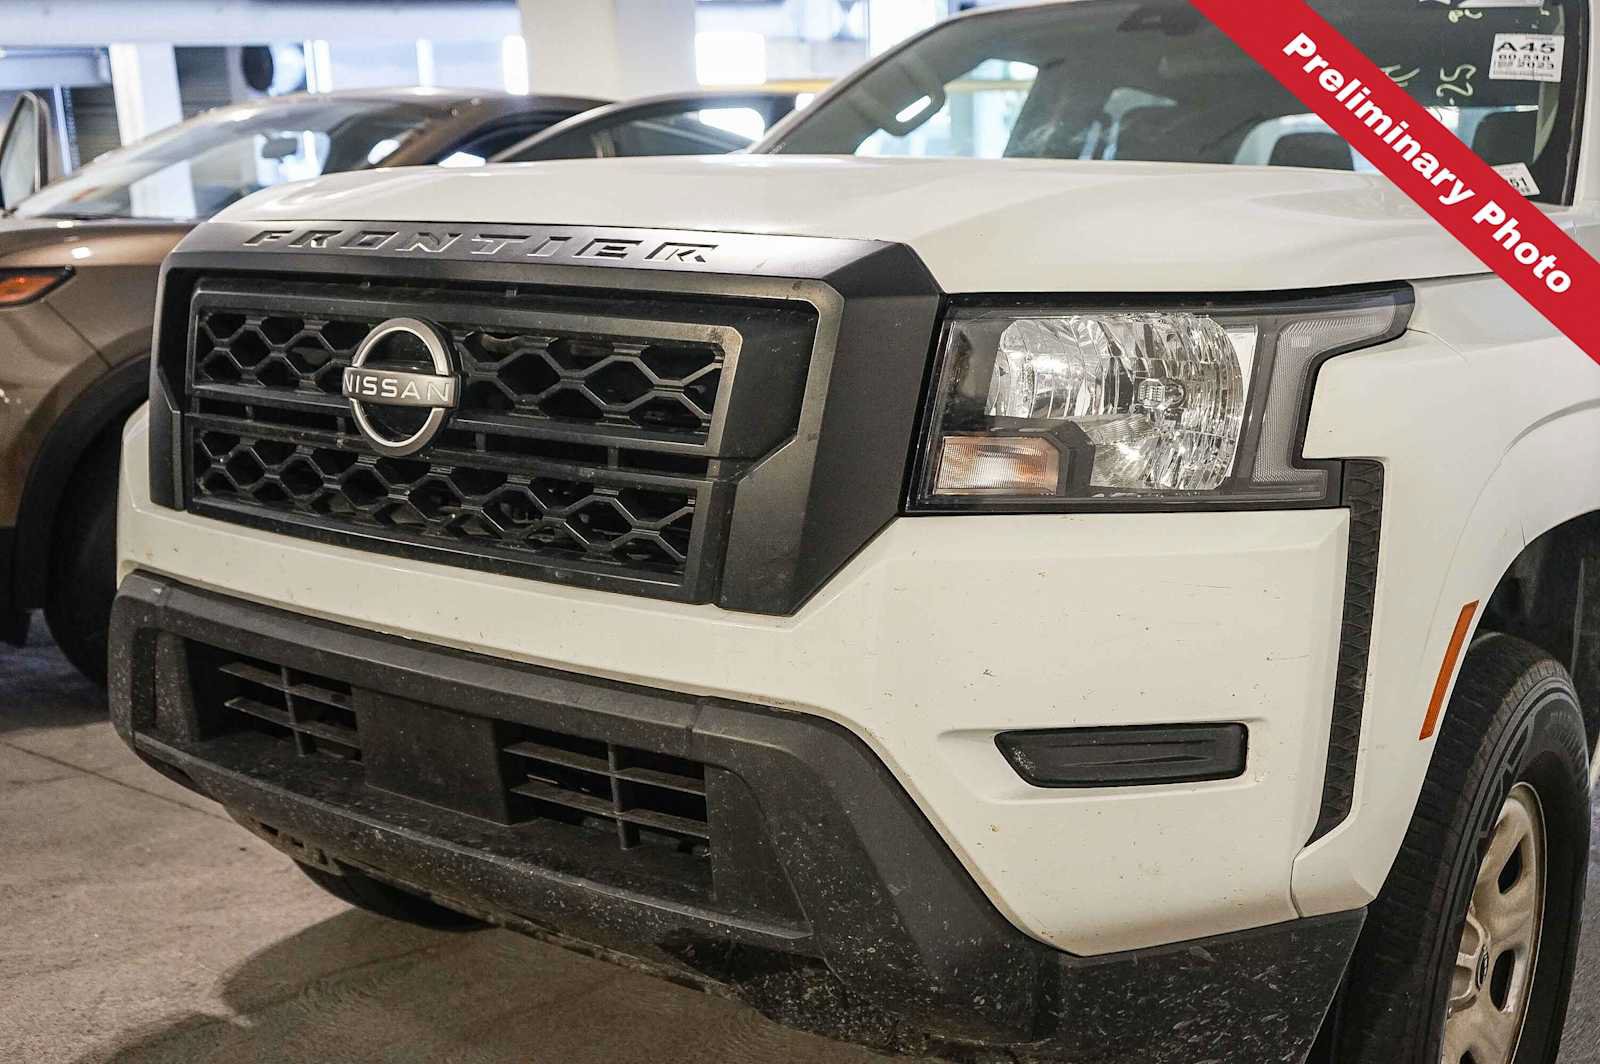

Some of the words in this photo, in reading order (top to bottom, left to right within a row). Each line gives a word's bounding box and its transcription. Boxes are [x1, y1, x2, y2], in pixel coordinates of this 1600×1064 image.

[1496, 41, 1555, 54] A45
[243, 229, 719, 263] FRONTIER
[342, 373, 451, 402] NISSAN
